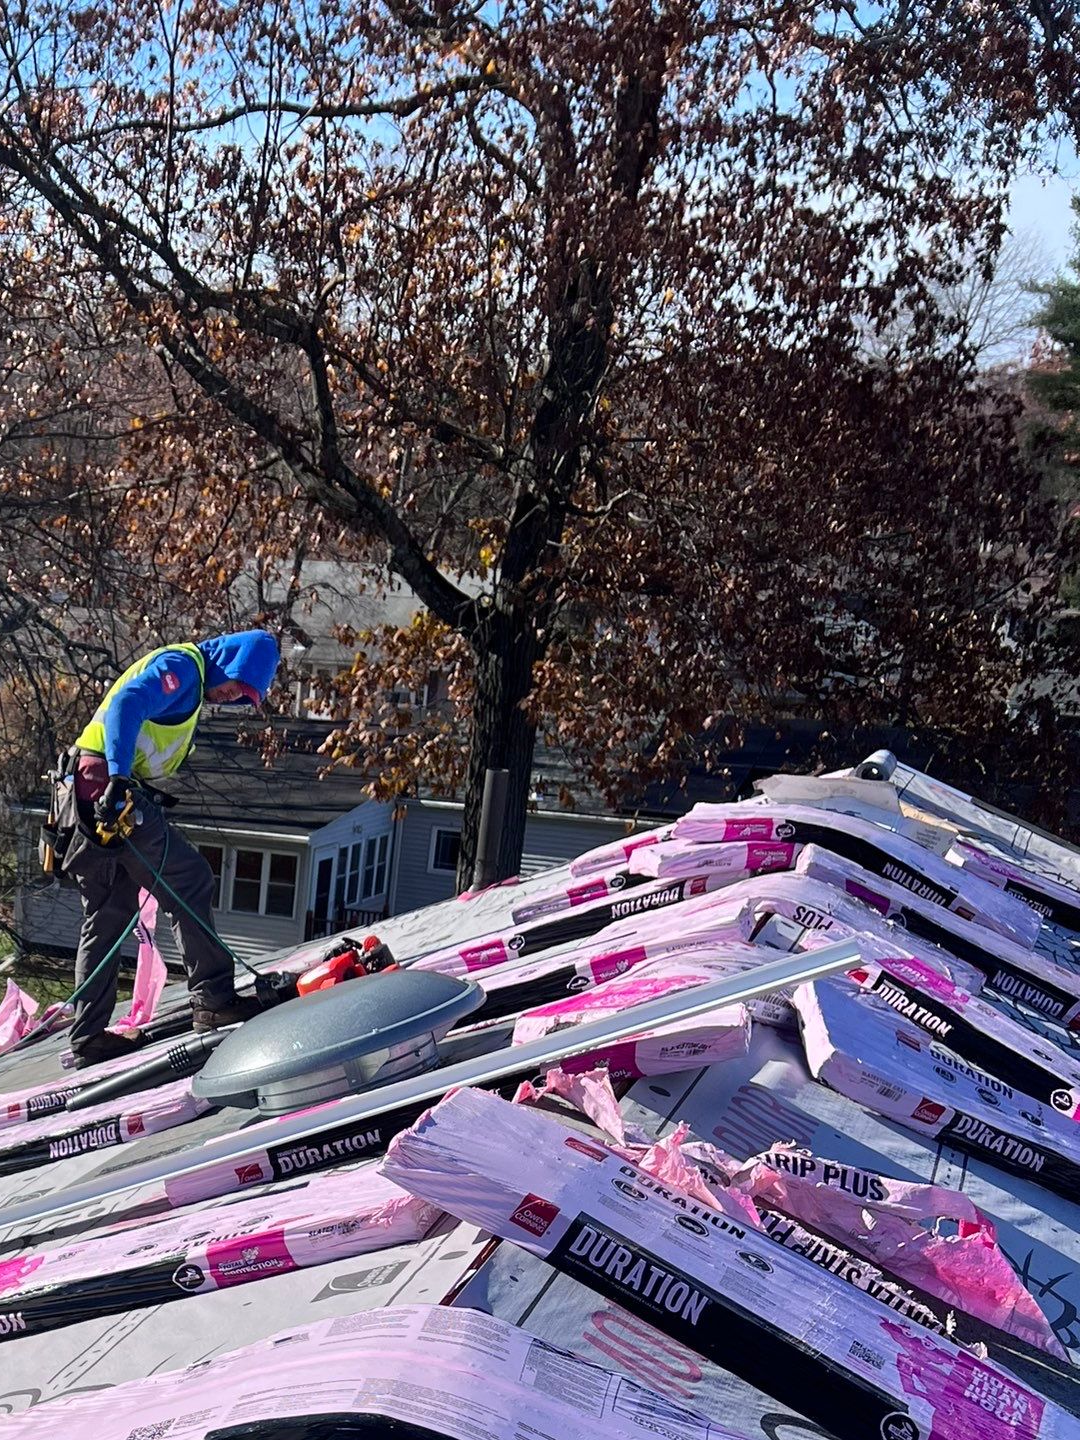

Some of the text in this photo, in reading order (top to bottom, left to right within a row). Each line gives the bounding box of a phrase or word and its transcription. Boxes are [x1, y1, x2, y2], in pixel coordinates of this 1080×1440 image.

[611, 886, 680, 919] DURATION
[877, 984, 953, 1037] DURATION
[993, 970, 1064, 1018] DURATION
[930, 1049, 1014, 1099] DURATION
[50, 1123, 117, 1158] DURATION
[277, 1129, 381, 1174] DURATION
[953, 1116, 1047, 1172] DURATION
[619, 1165, 746, 1240] DURATION
[823, 1164, 883, 1200] PLUS
[524, 1210, 549, 1227] OWENS
[569, 1225, 710, 1326] DURATION
[971, 1366, 1029, 1405] MORE
